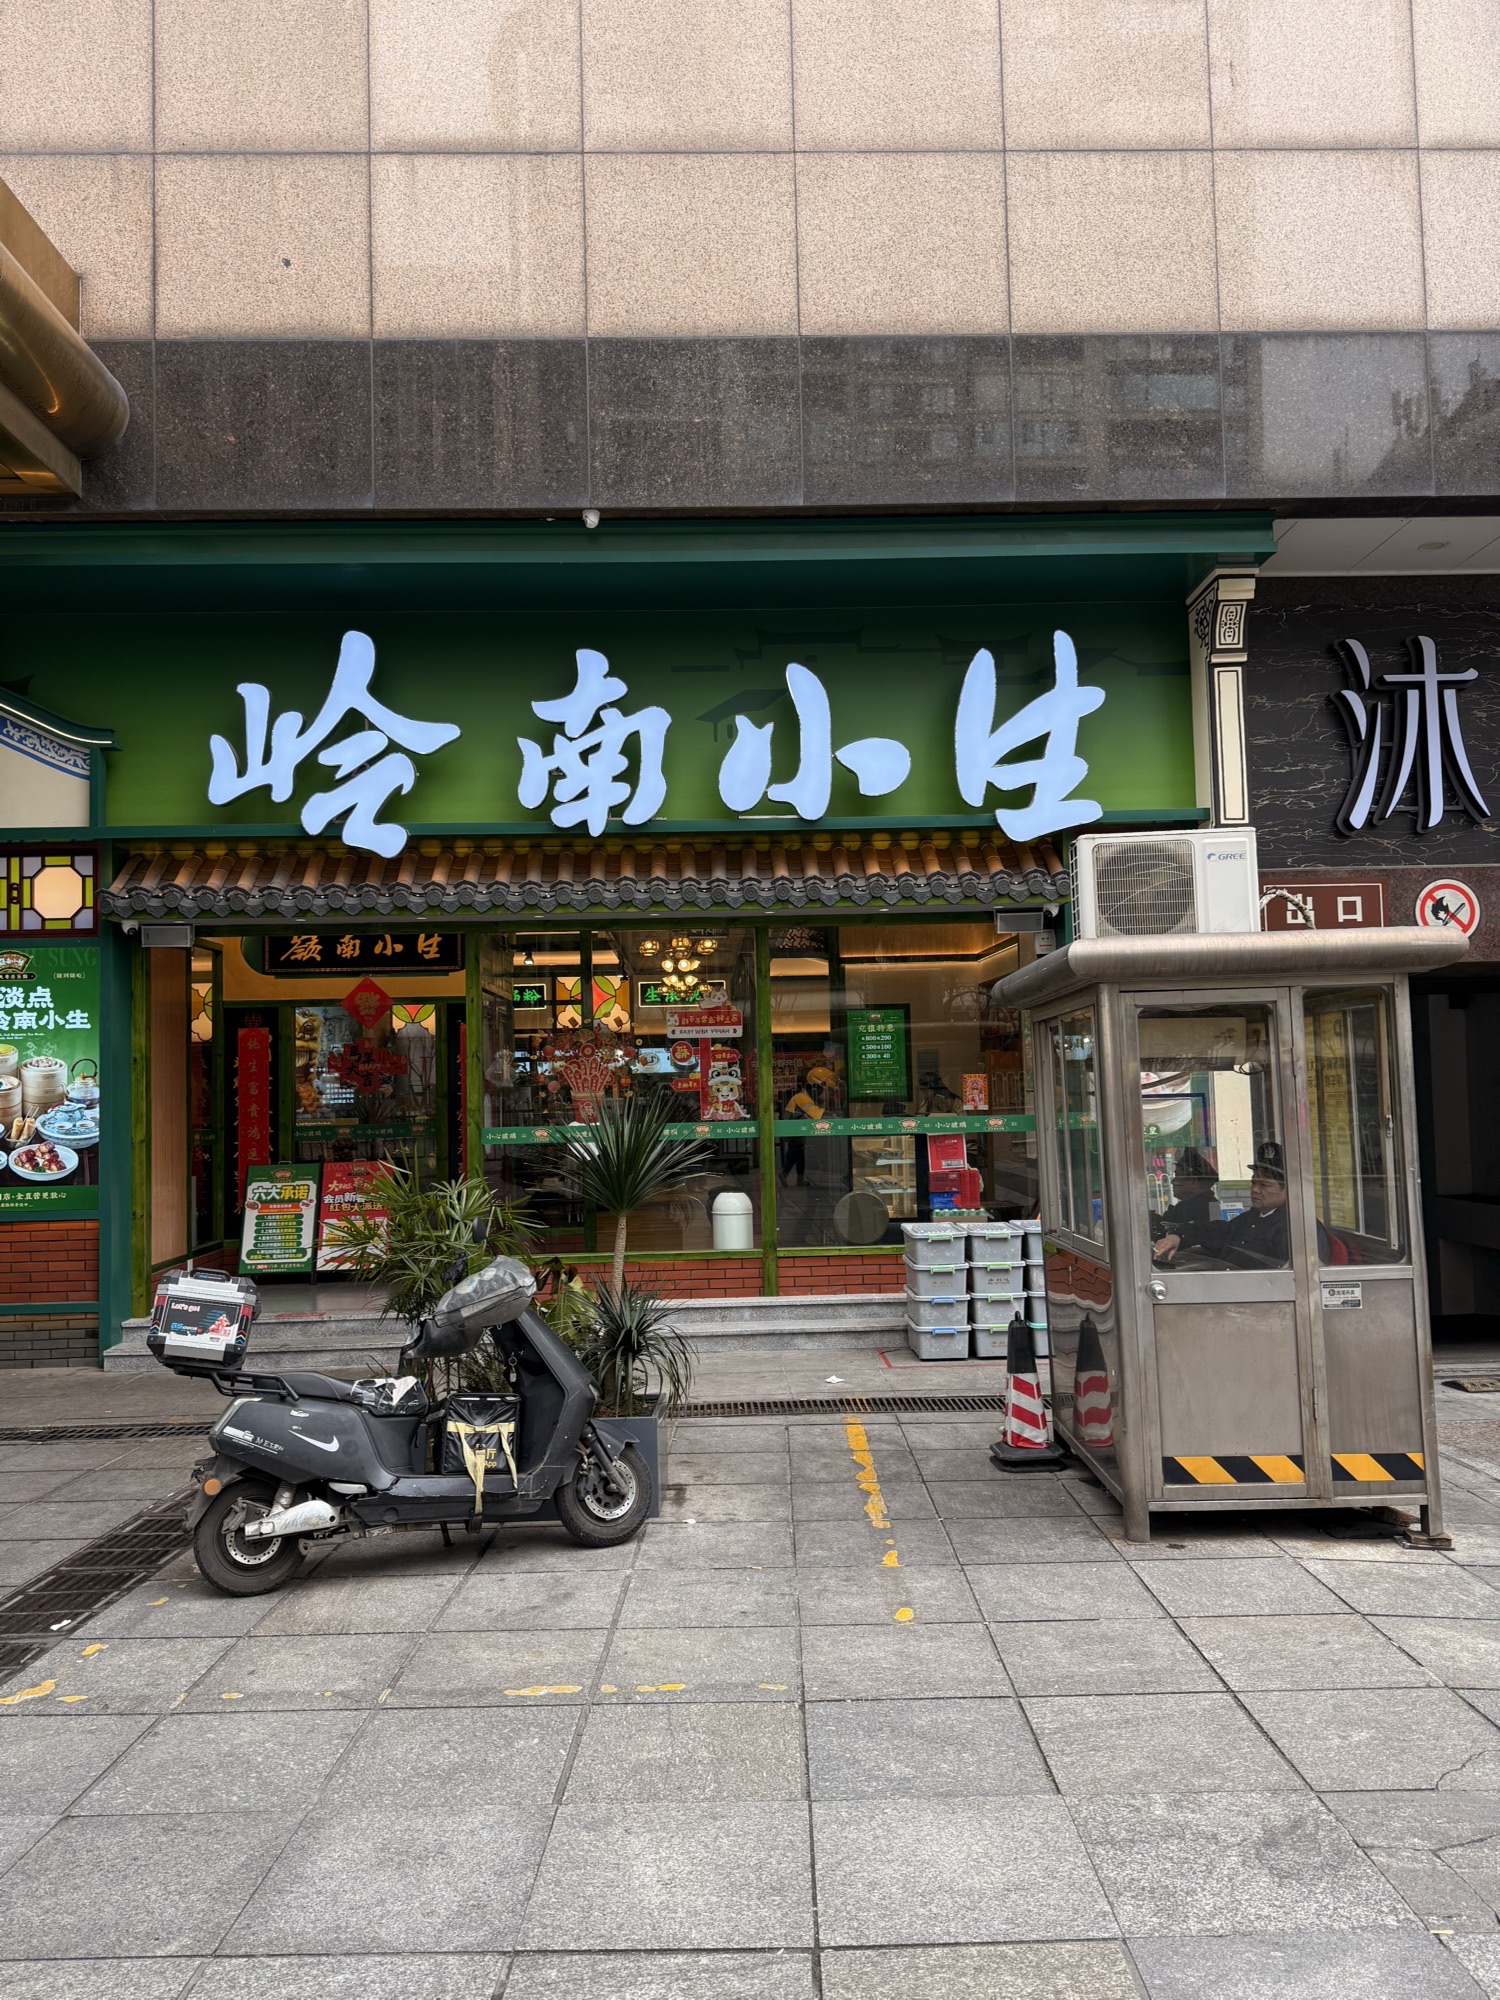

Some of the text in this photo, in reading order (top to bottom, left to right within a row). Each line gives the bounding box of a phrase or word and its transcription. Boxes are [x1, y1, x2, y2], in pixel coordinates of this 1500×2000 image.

[1331, 635, 1491, 833] 沐
[207, 630, 1105, 858] 岭南小生
[1218, 852, 1247, 861] GREE
[1286, 893, 1363, 924] 出口
[726, 1126, 756, 1134] 小心玻璃
[851, 1123, 883, 1131] 小心玻璃
[935, 1121, 967, 1129] 小心玻璃
[486, 1131, 517, 1140] 小心玻璃
[253, 1184, 309, 1201] 六大承诺
[171, 1302, 200, 1313] Let's go!
